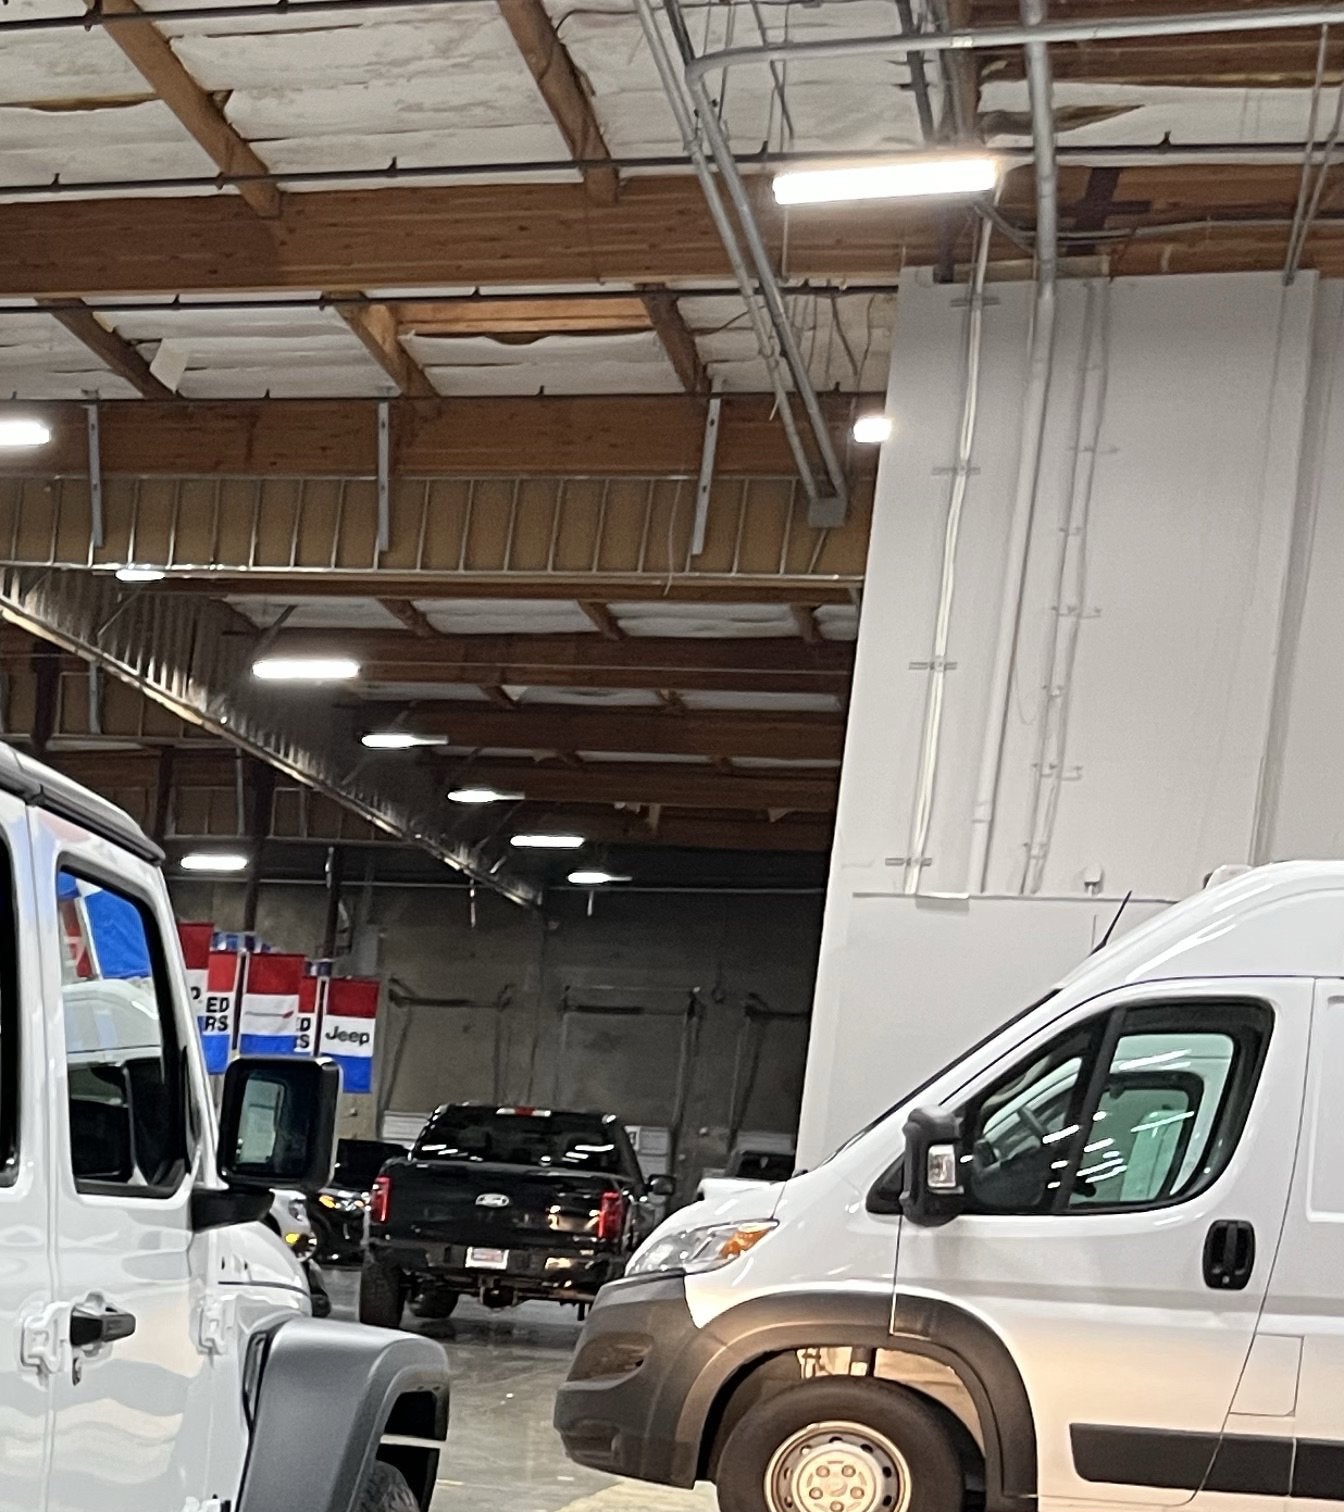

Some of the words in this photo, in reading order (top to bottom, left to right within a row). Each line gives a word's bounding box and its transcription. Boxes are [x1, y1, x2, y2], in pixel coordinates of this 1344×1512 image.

[205, 996, 230, 1013] ED
[204, 1015, 228, 1032] RS
[325, 1025, 370, 1046] Jeep
